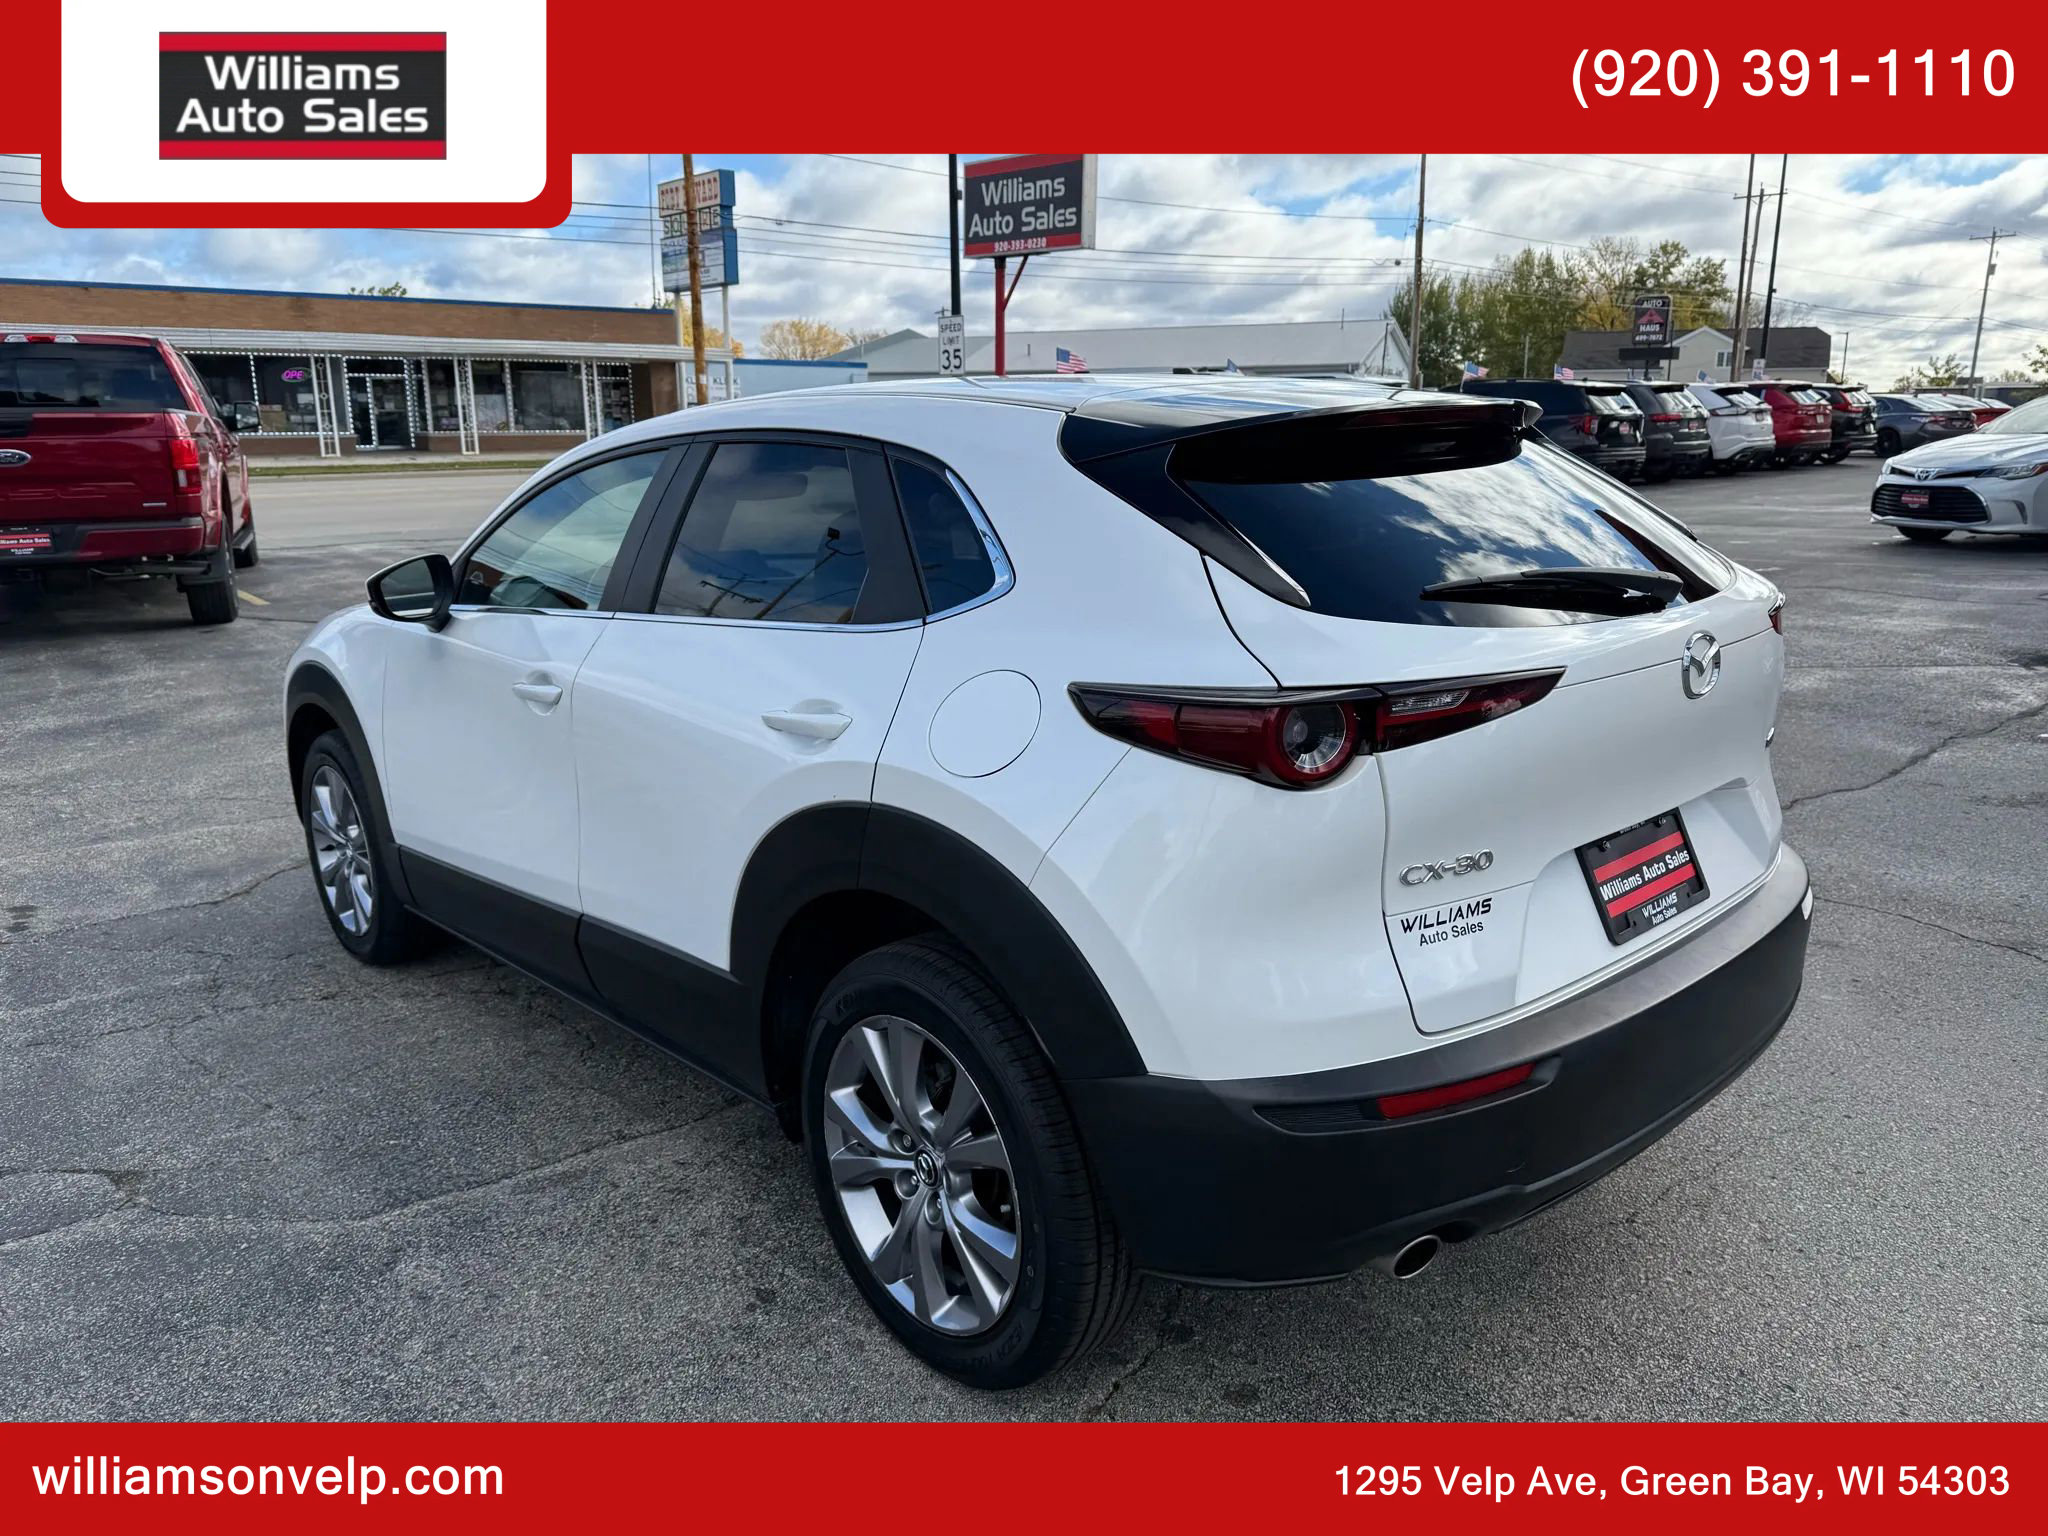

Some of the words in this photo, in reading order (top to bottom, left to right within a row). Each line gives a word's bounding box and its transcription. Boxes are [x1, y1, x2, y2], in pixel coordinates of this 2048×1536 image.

[981, 177, 1065, 206] Williams
[968, 209, 1014, 238] Auto
[1020, 206, 1077, 233] Sales
[993, 237, 1047, 252] 920-393-0230
[1642, 299, 1663, 308] AUTO
[940, 322, 962, 333] SPEED
[1639, 324, 1660, 332] HAUS
[942, 335, 960, 345] LIMIT
[942, 349, 962, 370] 35
[1399, 848, 1494, 886] CX-30
[1600, 872, 1643, 901] Williams
[1642, 862, 1666, 882] Auto
[1665, 849, 1690, 872] Sales
[1400, 897, 1493, 934] WILLIAMS
[1641, 891, 1679, 919] WILLIAMS
[1651, 913, 1665, 926] Auto
[1663, 906, 1678, 921] Sales
[1419, 930, 1449, 947] Auto
[1451, 921, 1485, 939] Sales
